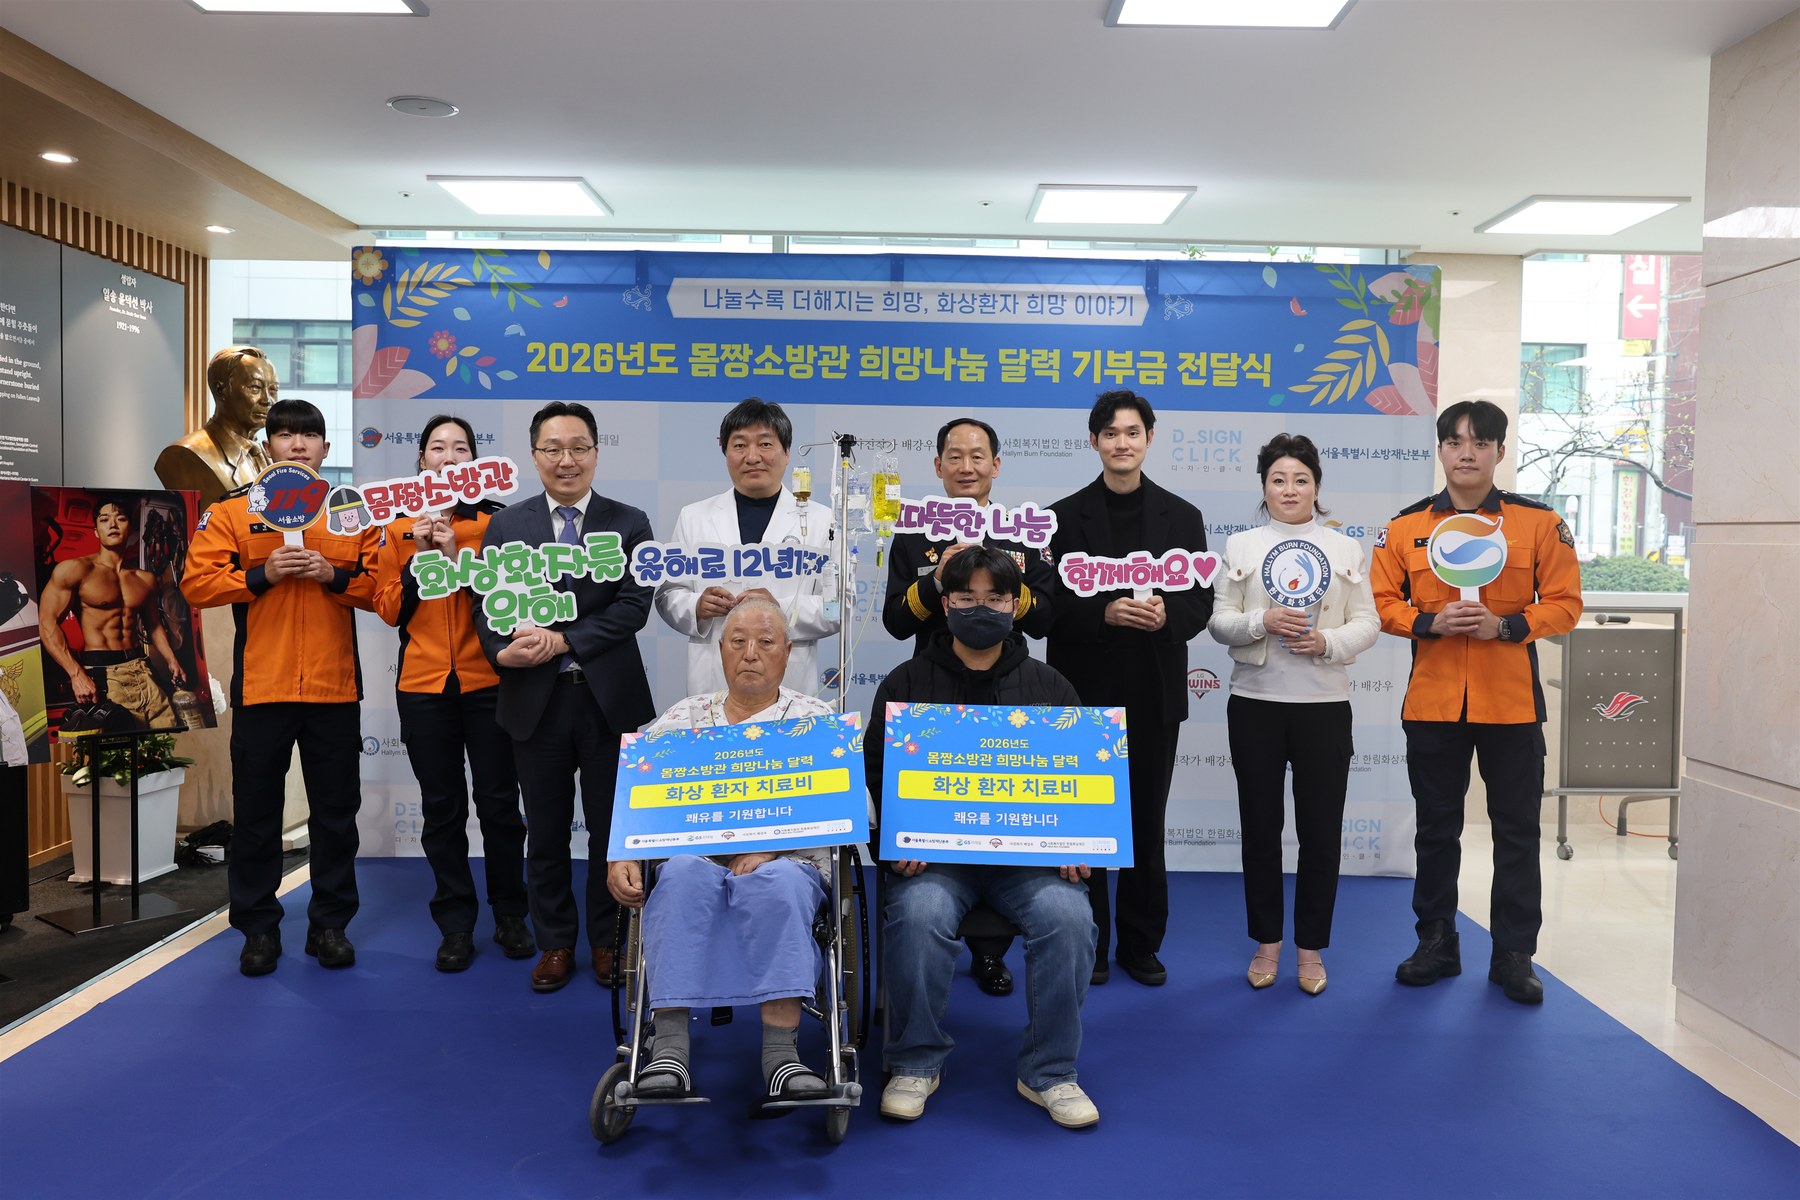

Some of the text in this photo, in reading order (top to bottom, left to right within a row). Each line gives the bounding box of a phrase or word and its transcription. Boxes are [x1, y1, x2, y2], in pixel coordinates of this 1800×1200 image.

[703, 287, 1135, 318] 나눌수록 더해지는 희망, 화상환자 희망 이야기
[14, 358, 23, 366] the
[527, 342, 1272, 389] 2026년도 몸짱소방관 희망나눔 달력 기부금 전달식
[385, 432, 422, 444] 서울특별
[598, 434, 619, 446] 테일
[902, 438, 935, 452] 배강우
[1003, 438, 1092, 450] 사회복지법인 한림화
[1002, 450, 1023, 458] Hallym
[1040, 450, 1073, 458] Foundation
[1172, 447, 1242, 463] CLICK
[1320, 447, 1431, 461] 서울특별시 소방재난본부
[262, 471, 277, 484] Seoul
[288, 467, 310, 481] Services
[267, 480, 330, 513] 119
[364, 461, 514, 521] 몸짱소방관
[278, 514, 305, 524] 서울소방
[895, 500, 1052, 543] 따뜻한 나눔
[1346, 526, 1365, 538] GS
[414, 534, 625, 597] 화상환자를
[635, 546, 726, 582] 올해로
[1264, 542, 1329, 578] HALLYM BURN FOUNDATION
[1064, 554, 1190, 592] 함께해요
[485, 586, 575, 633] 위해
[1188, 680, 1220, 689] WINS
[1361, 680, 1394, 692] 배강우
[980, 738, 1029, 750] 2026년도
[714, 748, 764, 760] 2026년도
[926, 752, 1079, 768] 몸짱소방관 희망나눔 달력
[660, 754, 814, 779] 몸짱소방관 희망나눔 달력
[665, 774, 813, 802] 화상 환자 치료비
[933, 776, 1078, 798] 화상 환자 치료비
[685, 806, 793, 824] 쾌유를 기원합니다
[953, 812, 1058, 827] 쾌유를 기원합니다
[1342, 818, 1382, 833] SIGN
[1166, 828, 1242, 840] 복지법인 한림화상
